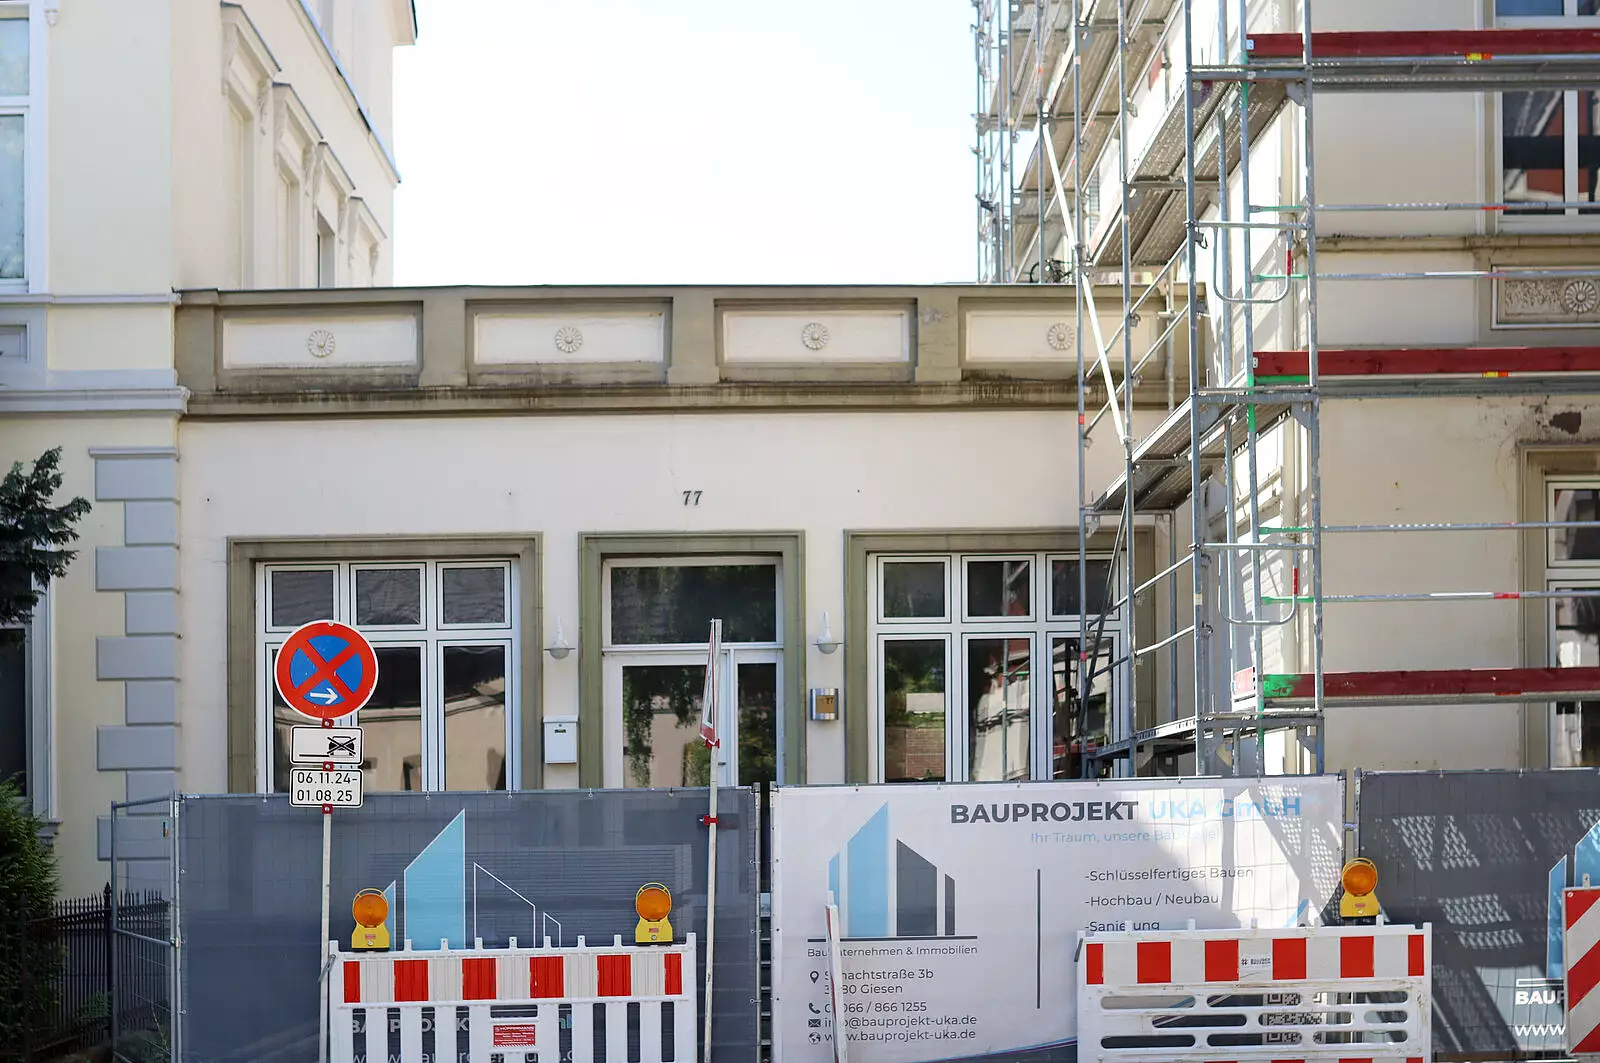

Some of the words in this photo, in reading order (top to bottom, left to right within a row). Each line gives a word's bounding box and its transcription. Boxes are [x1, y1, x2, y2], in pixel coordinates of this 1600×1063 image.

[682, 490, 703, 506] 77
[297, 772, 358, 784] 06.11.24-
[297, 789, 353, 802] 01.08.25
[951, 801, 1139, 824] BAUPROJEKT
[1150, 799, 1207, 819] UKA
[1219, 797, 1300, 818] GmbH
[1031, 832, 1049, 844] Ihr
[1052, 831, 1100, 844] Traum,
[1103, 832, 1150, 842] unsere
[1085, 867, 1206, 882] -Schlüsselfertiges
[1209, 867, 1254, 878] Bauen
[1085, 894, 1152, 907] -Hochbau
[1155, 893, 1162, 906] /
[1165, 893, 1219, 905] Neubau
[1084, 920, 1161, 932] -Sanieung
[807, 946, 903, 958] Bauternehmen
[905, 947, 913, 956] &
[916, 945, 978, 956] Immobilien
[918, 968, 934, 979] 3b
[824, 984, 857, 995] 380
[860, 984, 903, 994] Giesen
[824, 1002, 864, 1013] 066
[866, 1001, 872, 1013] /
[874, 1002, 898, 1012] 866
[901, 1002, 927, 1012] 1255
[824, 1015, 977, 1029] i@bauprojekt-uka.de
[824, 1029, 976, 1043] ww.bauprojekt-uka.de
